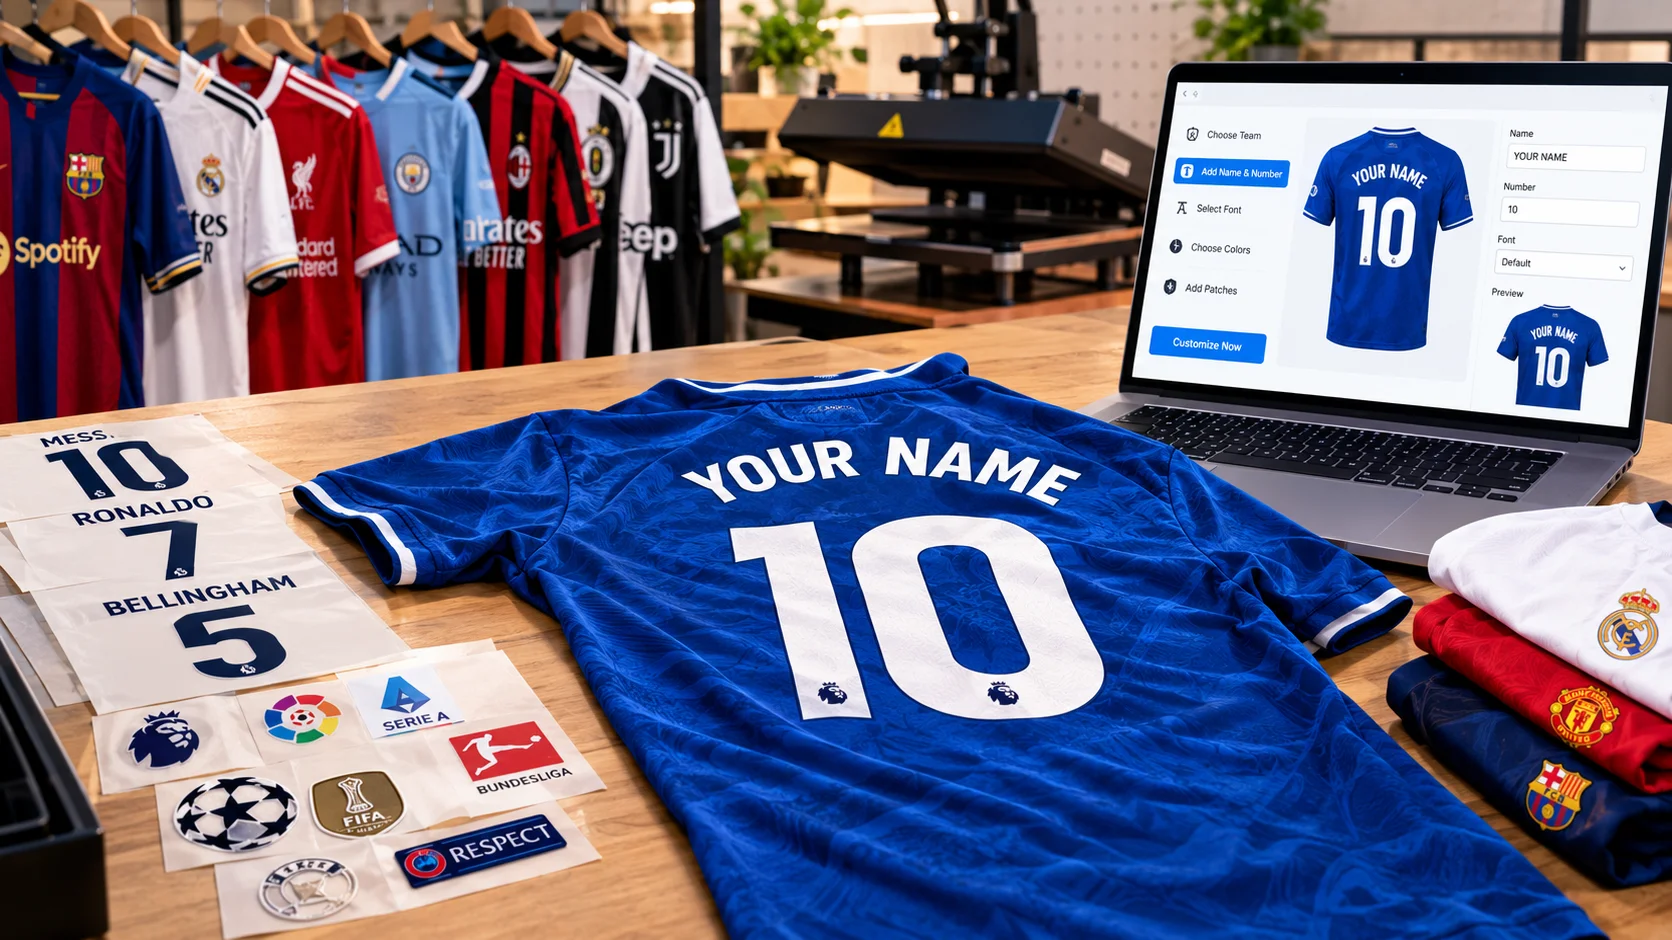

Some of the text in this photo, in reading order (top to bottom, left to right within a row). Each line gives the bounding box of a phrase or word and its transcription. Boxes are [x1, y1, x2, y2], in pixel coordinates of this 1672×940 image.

[1207, 130, 1262, 140] Choose Team
[1509, 129, 1534, 138] Name
[1513, 151, 1568, 162] YOUR NAME
[1201, 167, 1283, 179] Add Name & Number
[1351, 163, 1428, 190] YOUR NAME
[1503, 182, 1536, 192] Number
[1196, 203, 1242, 215] Select Font
[1508, 204, 1518, 215] 10
[1357, 196, 1417, 268] 10
[1497, 234, 1516, 245] Font
[15, 236, 101, 270] Spotify
[474, 246, 526, 270] BETTER
[1190, 242, 1251, 255] Choose Colors
[1501, 257, 1532, 268] Default
[1184, 283, 1238, 296] Add Patches
[1491, 287, 1524, 298] Preview
[1172, 337, 1243, 352] Customize Now
[1530, 325, 1579, 344] YOUR NAME
[1534, 345, 1571, 388] 10
[45, 440, 190, 501] 10
[680, 439, 861, 504] YOUR
[884, 436, 1082, 507] NAME
[72, 495, 214, 526] RONALDO
[119, 520, 199, 581] 7
[102, 574, 297, 617] BELLINGHAM
[729, 515, 1105, 721] 10
[172, 604, 287, 679] 5
[382, 711, 450, 732] SERIE A
[476, 767, 573, 795] BUNDESLIGA
[343, 811, 386, 828] FIFA
[449, 823, 552, 864] RESPECT
